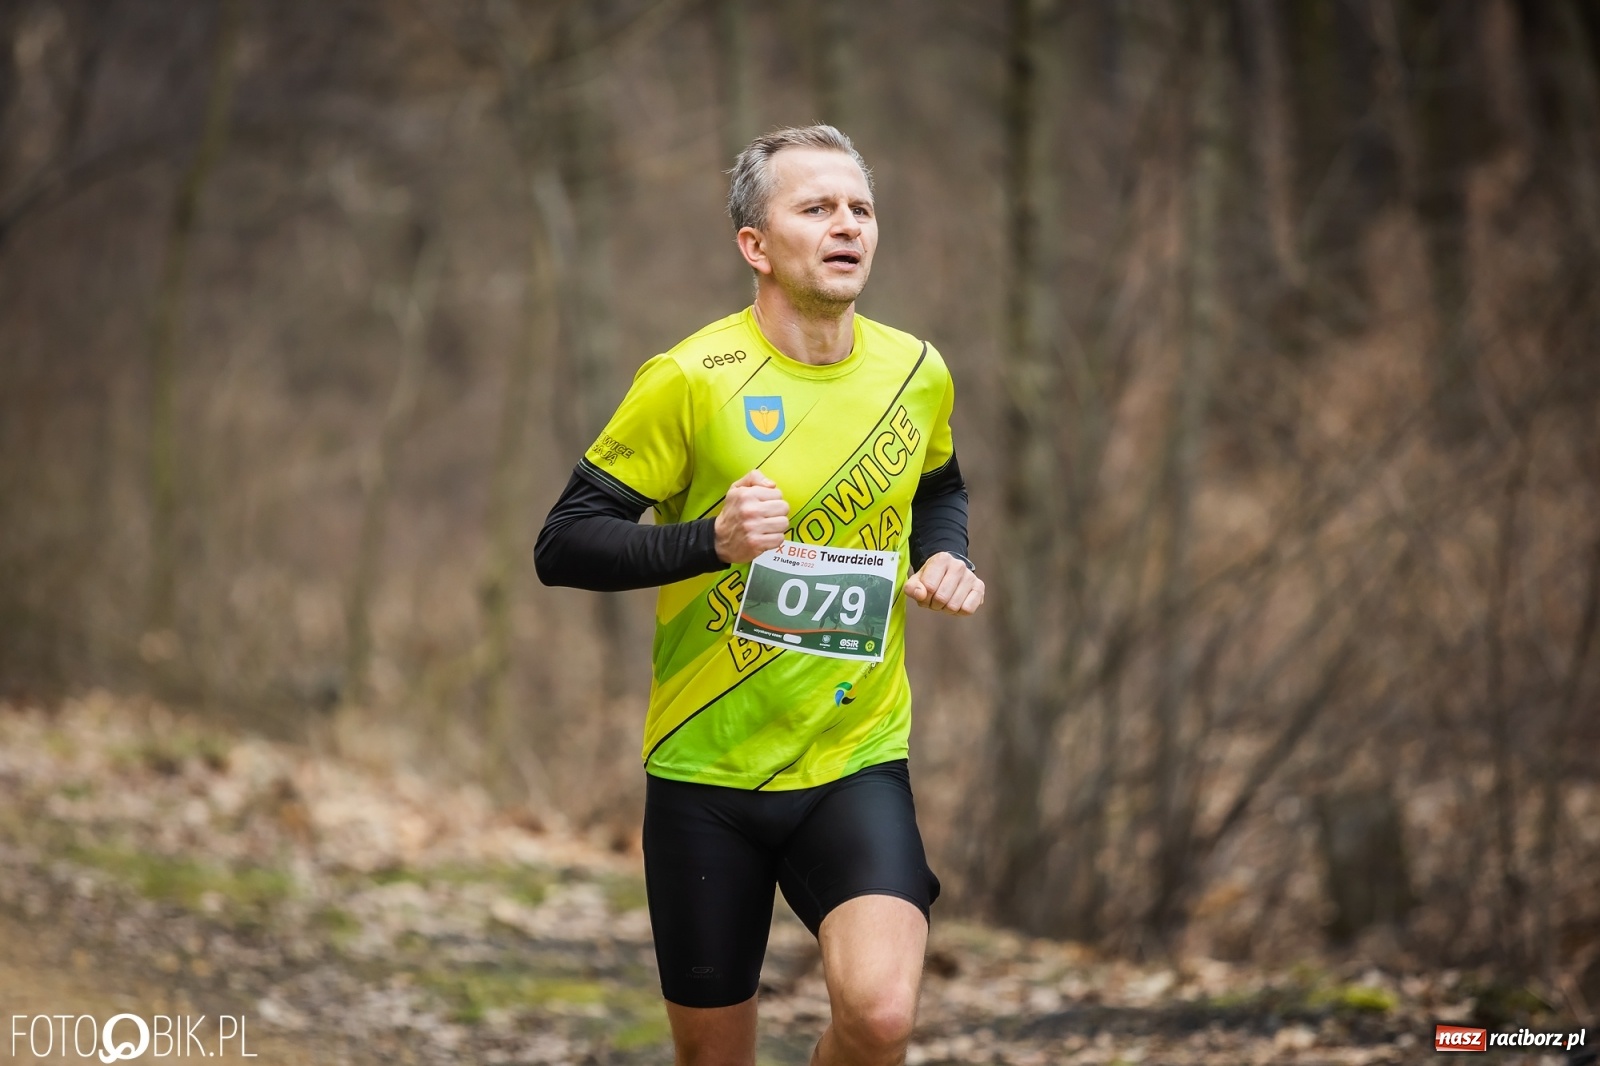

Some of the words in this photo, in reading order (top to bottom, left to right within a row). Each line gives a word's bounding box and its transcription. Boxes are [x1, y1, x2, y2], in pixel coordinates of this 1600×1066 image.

[702, 350, 747, 369] deep
[780, 557, 800, 567] lutego
[800, 561, 815, 569] 2022
[787, 546, 817, 560] BIEG
[820, 551, 884, 566] Twardziela
[777, 578, 866, 626] 079
